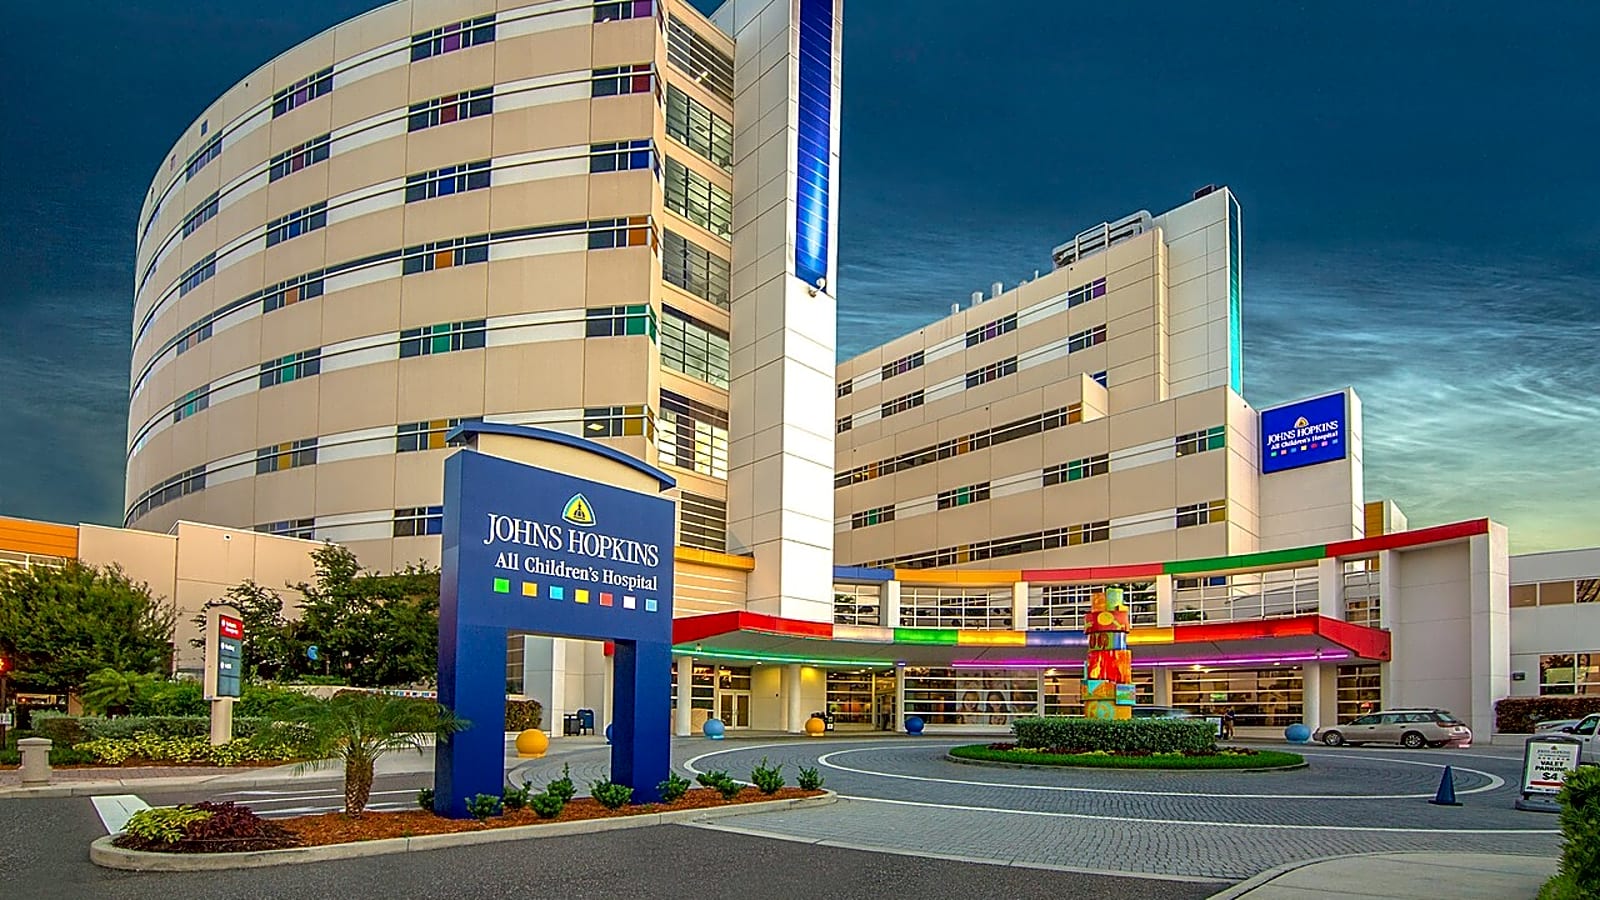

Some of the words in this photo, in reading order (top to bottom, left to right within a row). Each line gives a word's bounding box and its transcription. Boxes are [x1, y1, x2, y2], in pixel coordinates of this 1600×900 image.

[1267, 430, 1295, 445] JOHNS
[1297, 421, 1338, 437] HOPKINS
[483, 513, 563, 551] JOHNS
[568, 529, 659, 568] HOPKINS
[494, 552, 519, 571] All
[524, 556, 599, 582] Children's
[602, 569, 658, 591] Hospital
[1542, 772, 1558, 781] $4
